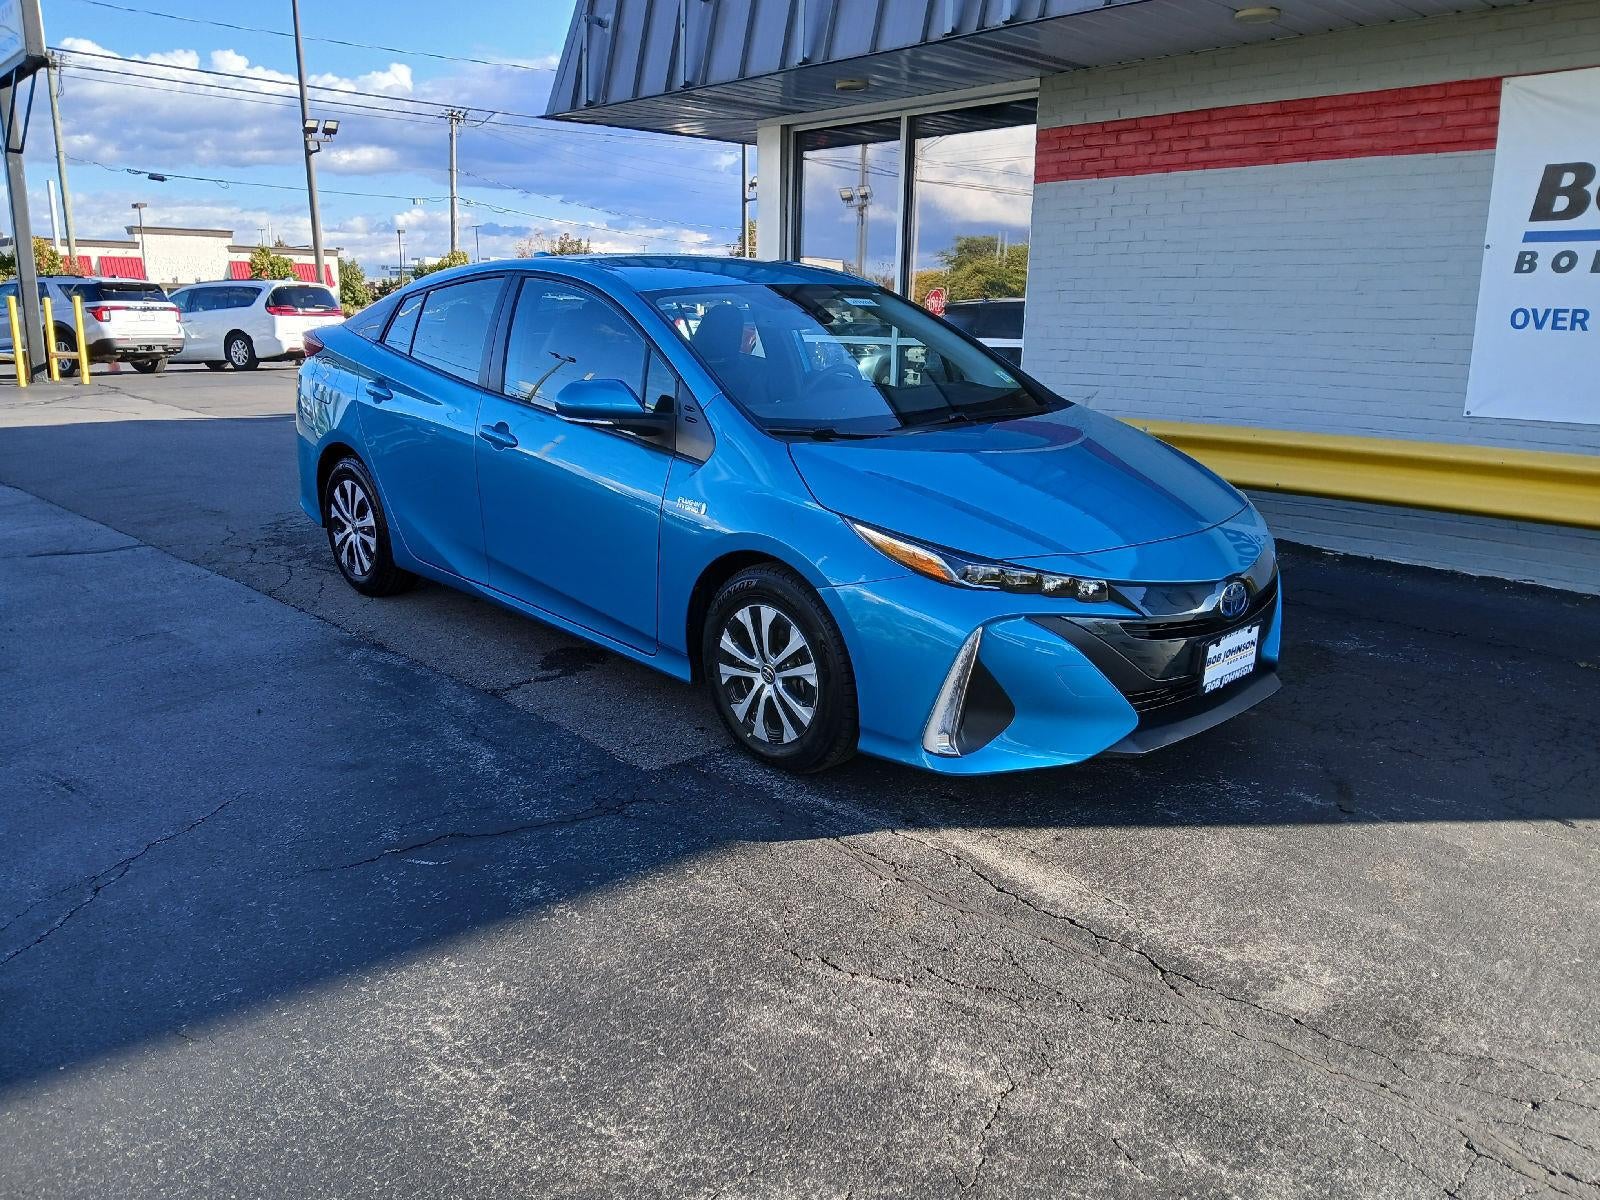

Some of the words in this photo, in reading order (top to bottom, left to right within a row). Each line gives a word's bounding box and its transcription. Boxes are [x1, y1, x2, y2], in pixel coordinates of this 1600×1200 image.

[1510, 308, 1590, 332] OVER
[1206, 652, 1223, 667] BOB
[1222, 638, 1257, 663] JOHNSON
[1205, 677, 1221, 693] BOB
[1220, 663, 1255, 688] JOHNSON
